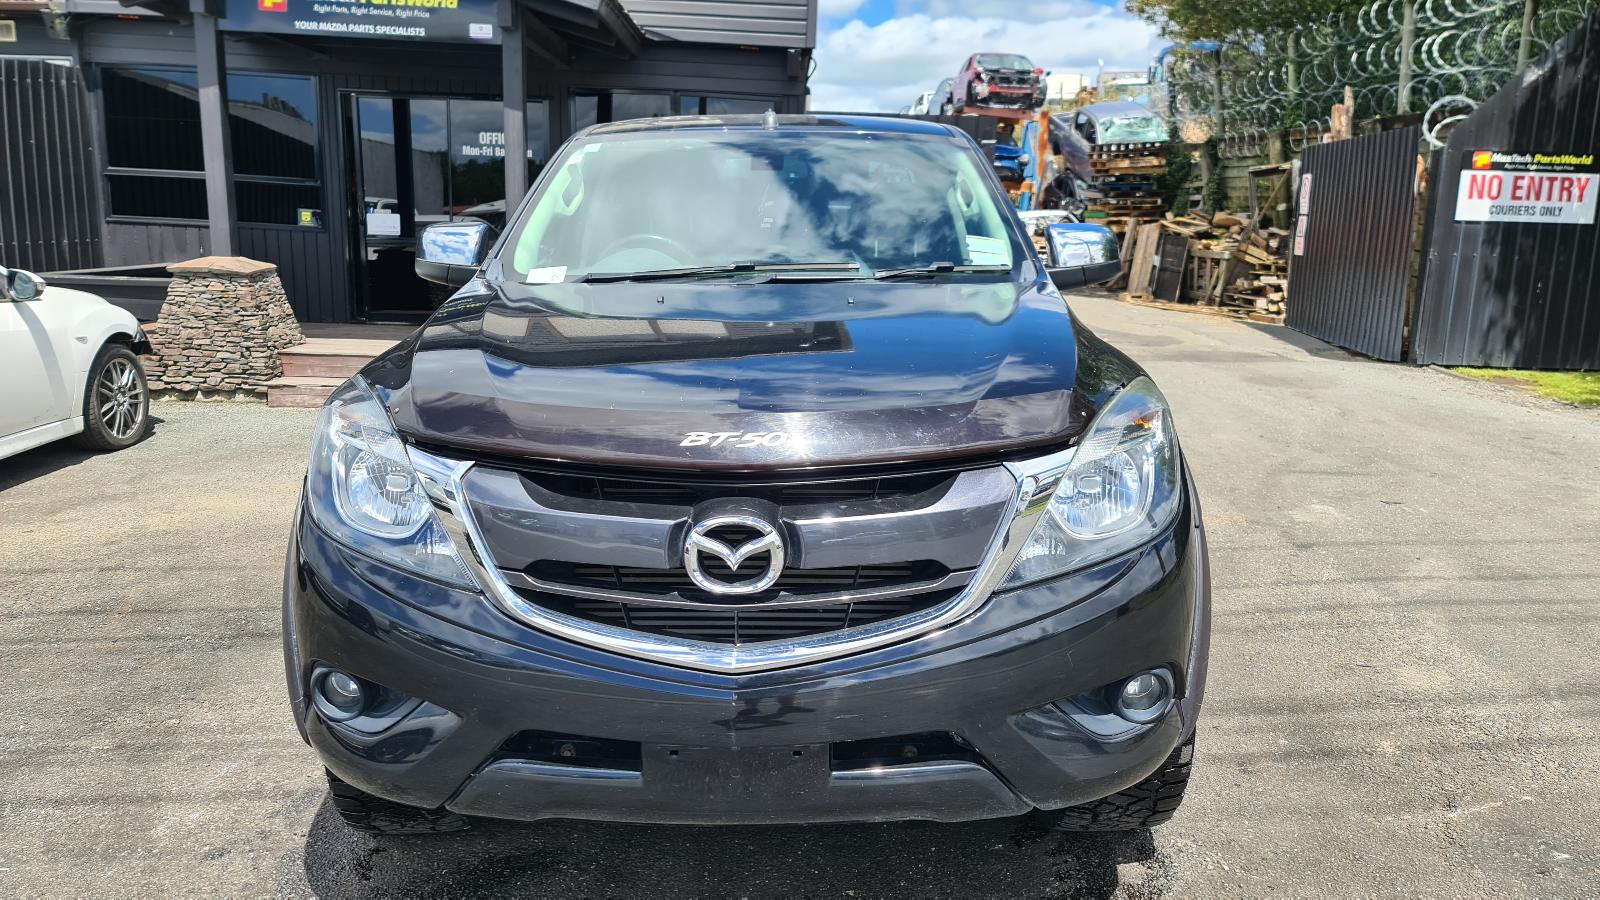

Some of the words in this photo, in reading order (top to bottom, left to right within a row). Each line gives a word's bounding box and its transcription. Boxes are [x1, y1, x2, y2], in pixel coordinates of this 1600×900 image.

[313, 4, 331, 13] Right
[331, 5, 349, 14] Parts,
[351, 6, 368, 15] Right
[369, 7, 394, 17] Service,
[396, 8, 413, 18] Right
[414, 10, 430, 18] Price
[294, 20, 318, 30] YOUR
[319, 21, 348, 32] MAZDA
[348, 23, 375, 34] PARTS
[375, 25, 426, 36] SPECIALISTS
[479, 132, 505, 145] OFFIC
[462, 145, 493, 157] Mon-Fri
[1533, 153, 1594, 165] PartsWorld
[1468, 174, 1503, 200] NO
[1511, 175, 1590, 203] ENTRY
[1489, 204, 1536, 216] COURIERS
[1539, 206, 1563, 217] ONLY
[679, 430, 786, 448] BT-50
